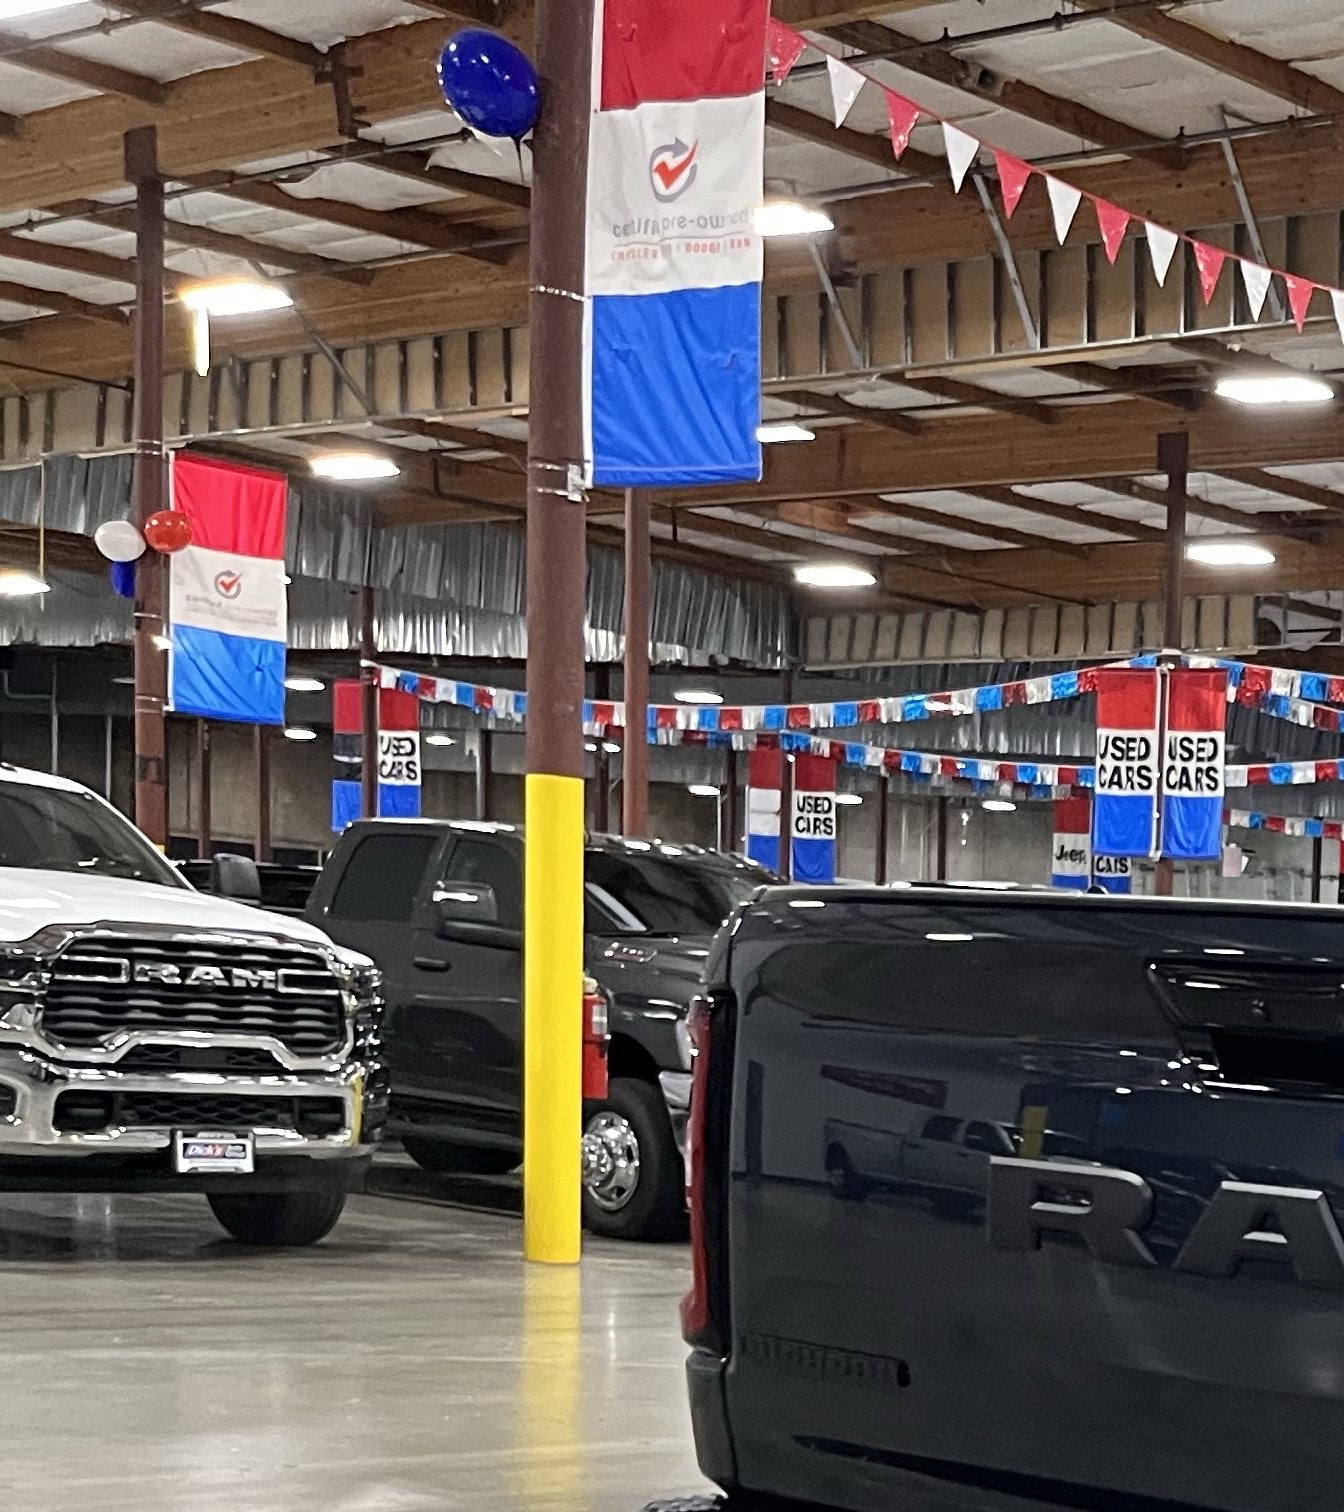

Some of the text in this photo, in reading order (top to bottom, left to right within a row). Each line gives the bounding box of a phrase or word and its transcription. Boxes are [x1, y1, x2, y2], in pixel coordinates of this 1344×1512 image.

[380, 736, 416, 757] UED
[1098, 736, 1151, 762] USED
[1168, 736, 1218, 762] USED
[1098, 765, 1152, 791] CARS
[1166, 765, 1219, 792] CARS
[797, 796, 832, 814] USED
[134, 960, 277, 989] RAM
